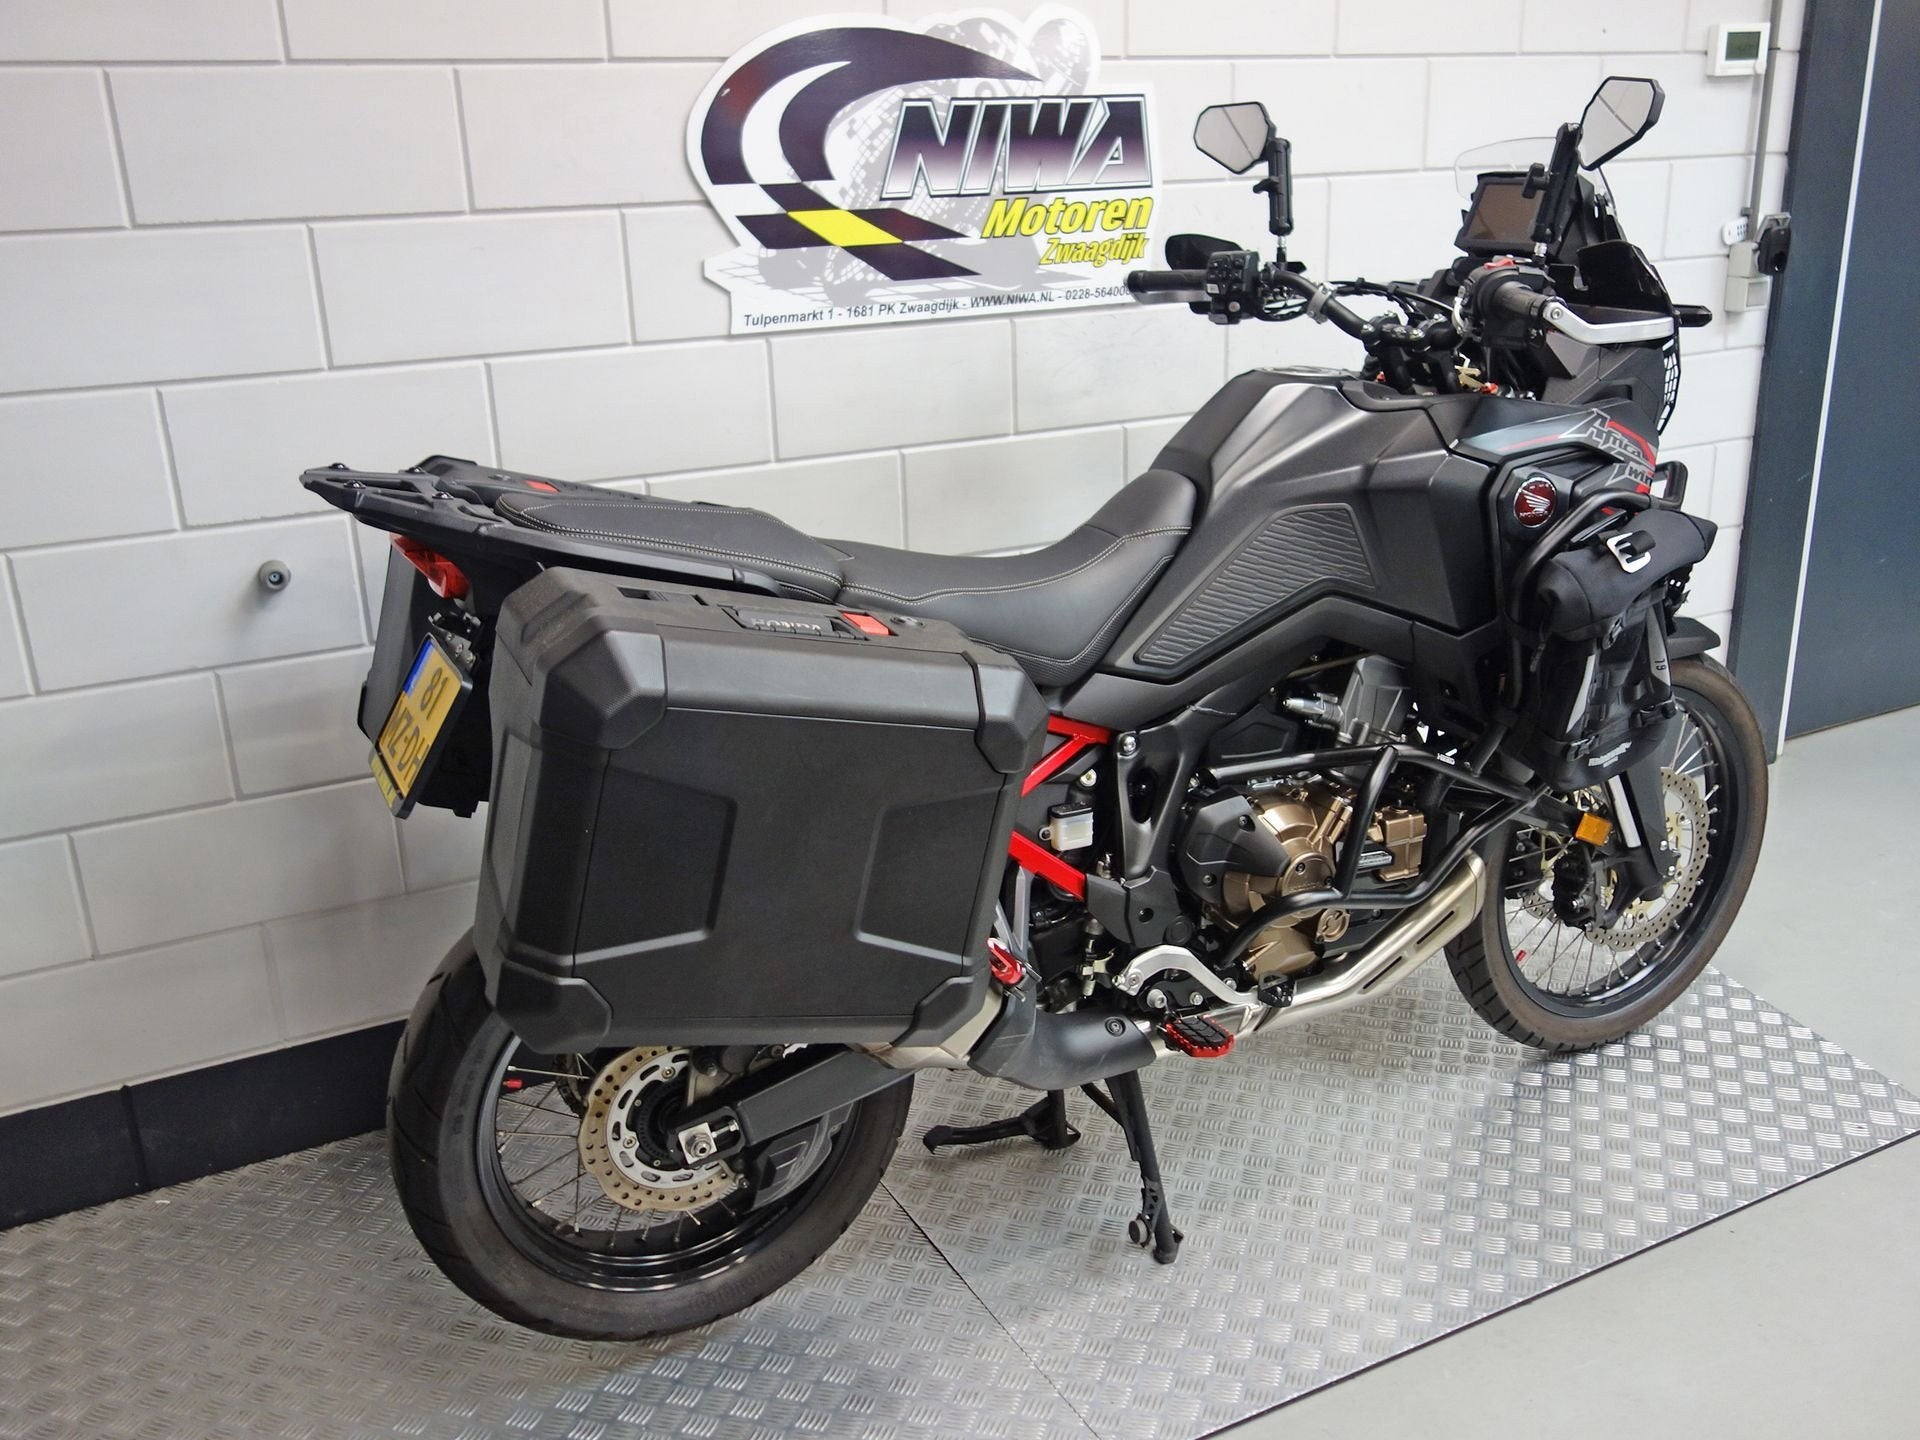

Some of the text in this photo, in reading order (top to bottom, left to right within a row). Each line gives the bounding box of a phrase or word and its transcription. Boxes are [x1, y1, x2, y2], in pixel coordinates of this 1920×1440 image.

[880, 94, 1153, 201] NIWA
[980, 196, 1154, 239] Motoren
[1039, 232, 1148, 268] Zwaagdijk
[744, 308, 824, 327] Tulpenmarkt
[828, 307, 834, 320] 1
[847, 304, 874, 319] 1681
[878, 303, 896, 316] PK
[899, 298, 960, 315] Zwaagdijk
[970, 290, 1055, 308] WWW.NIWA.NL
[420, 667, 448, 720] 81
